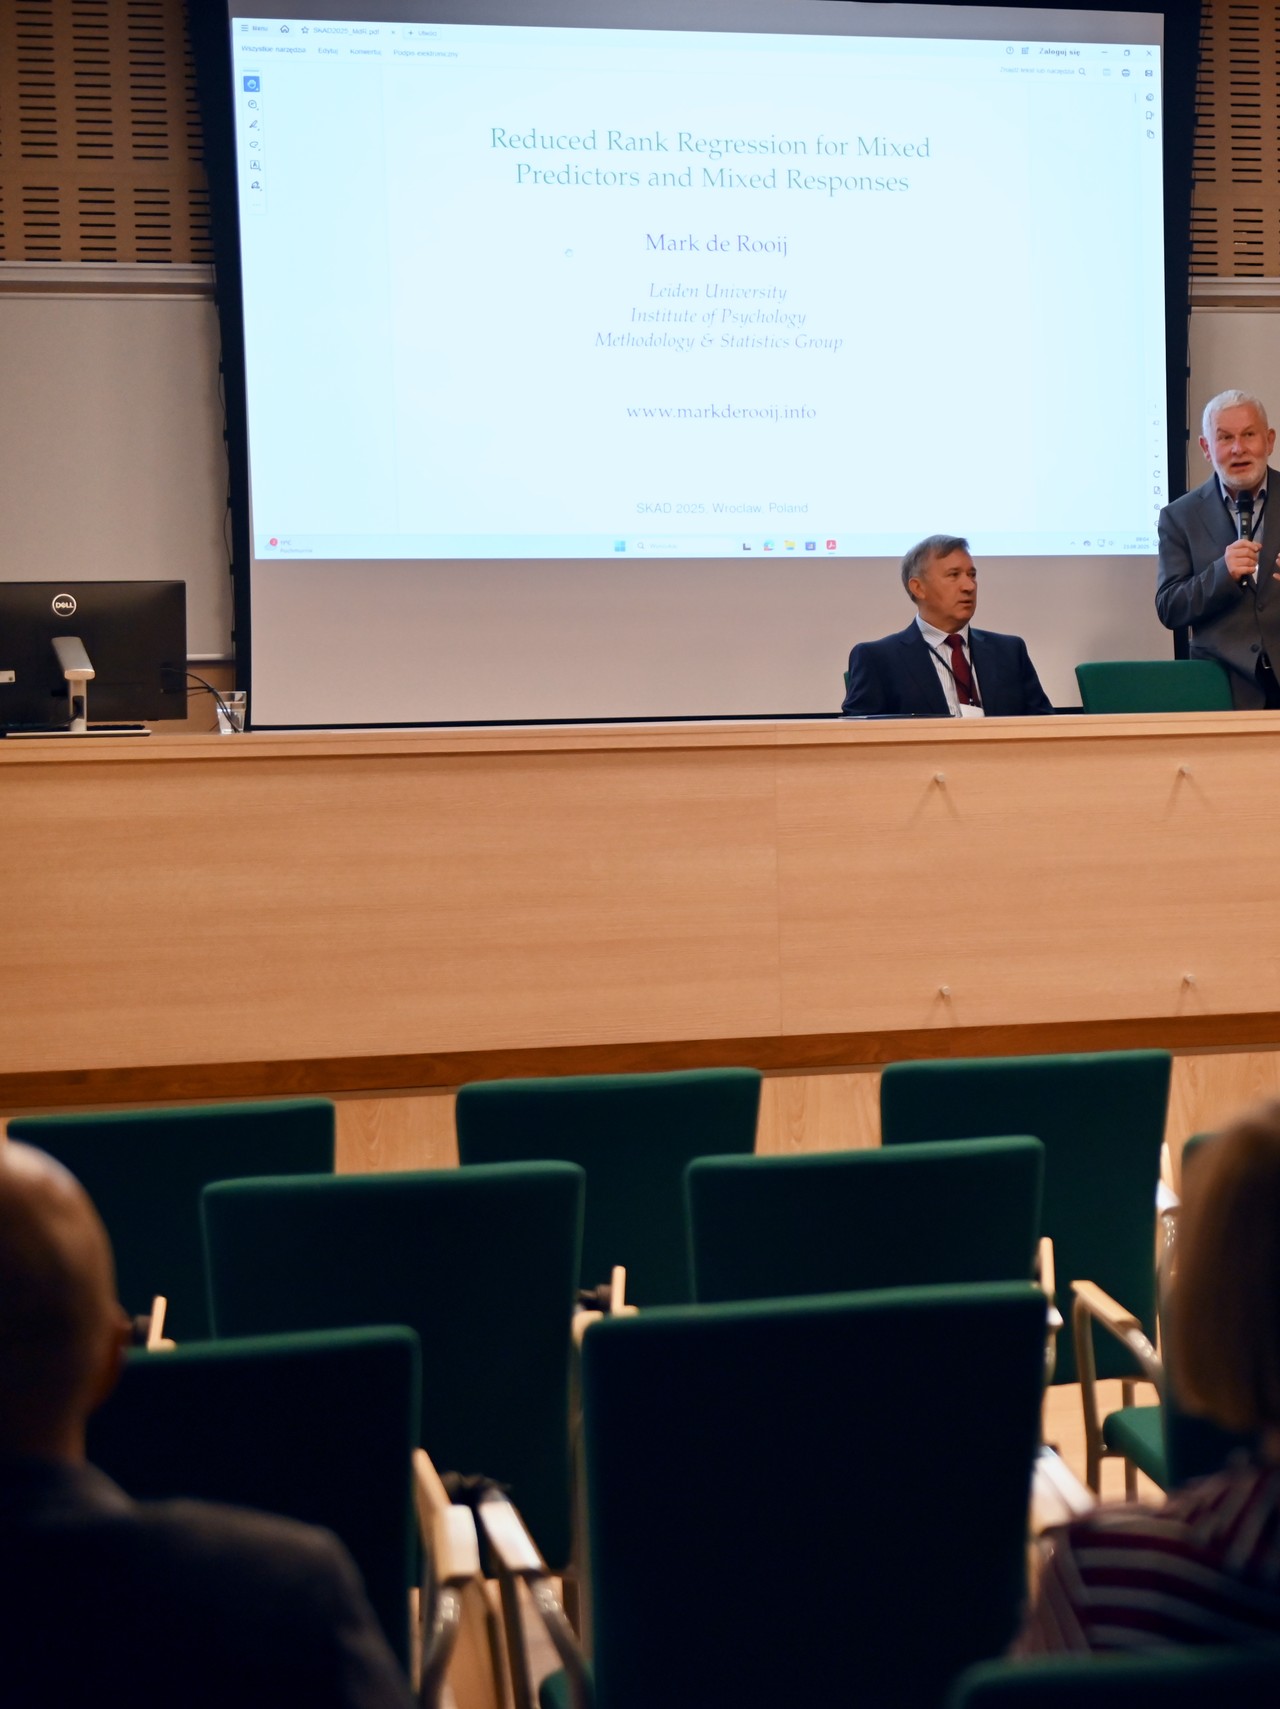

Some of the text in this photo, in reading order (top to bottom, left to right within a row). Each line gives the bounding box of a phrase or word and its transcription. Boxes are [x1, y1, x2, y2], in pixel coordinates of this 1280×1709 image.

[1039, 47, 1067, 56] Zaloguj
[490, 127, 930, 160] Reduced Rank Regression for Mixed
[516, 163, 910, 197] Predictors and Mixed Responses
[645, 233, 788, 257] Mark de Rooij
[649, 282, 787, 303] Leiden University
[630, 307, 807, 328] Institute of Psychology
[594, 332, 843, 353] Methodology & Statistics Group
[626, 403, 817, 422] www.markderooij.info
[636, 502, 672, 514] SKAD
[768, 502, 809, 513] Poland
